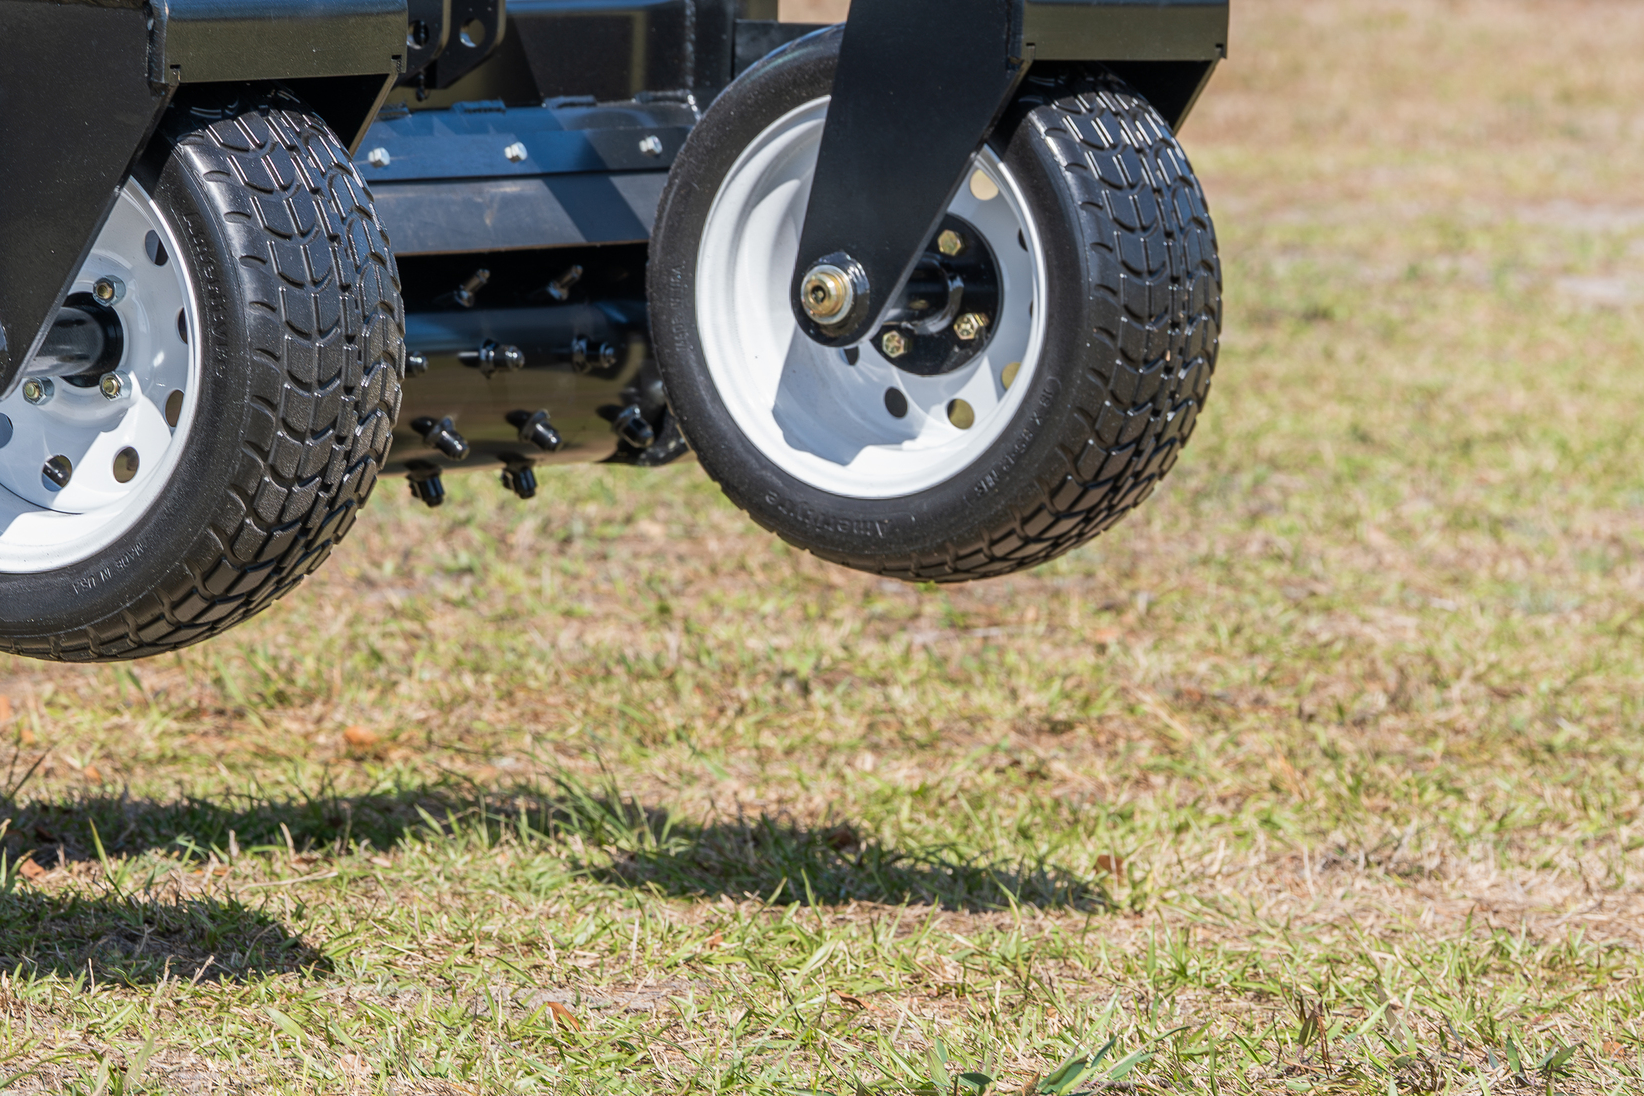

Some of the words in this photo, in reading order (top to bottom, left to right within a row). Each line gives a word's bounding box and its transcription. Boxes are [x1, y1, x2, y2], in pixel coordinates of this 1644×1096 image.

[116, 542, 144, 569] MADE
[72, 574, 97, 594] USA
[99, 567, 112, 582] IN
